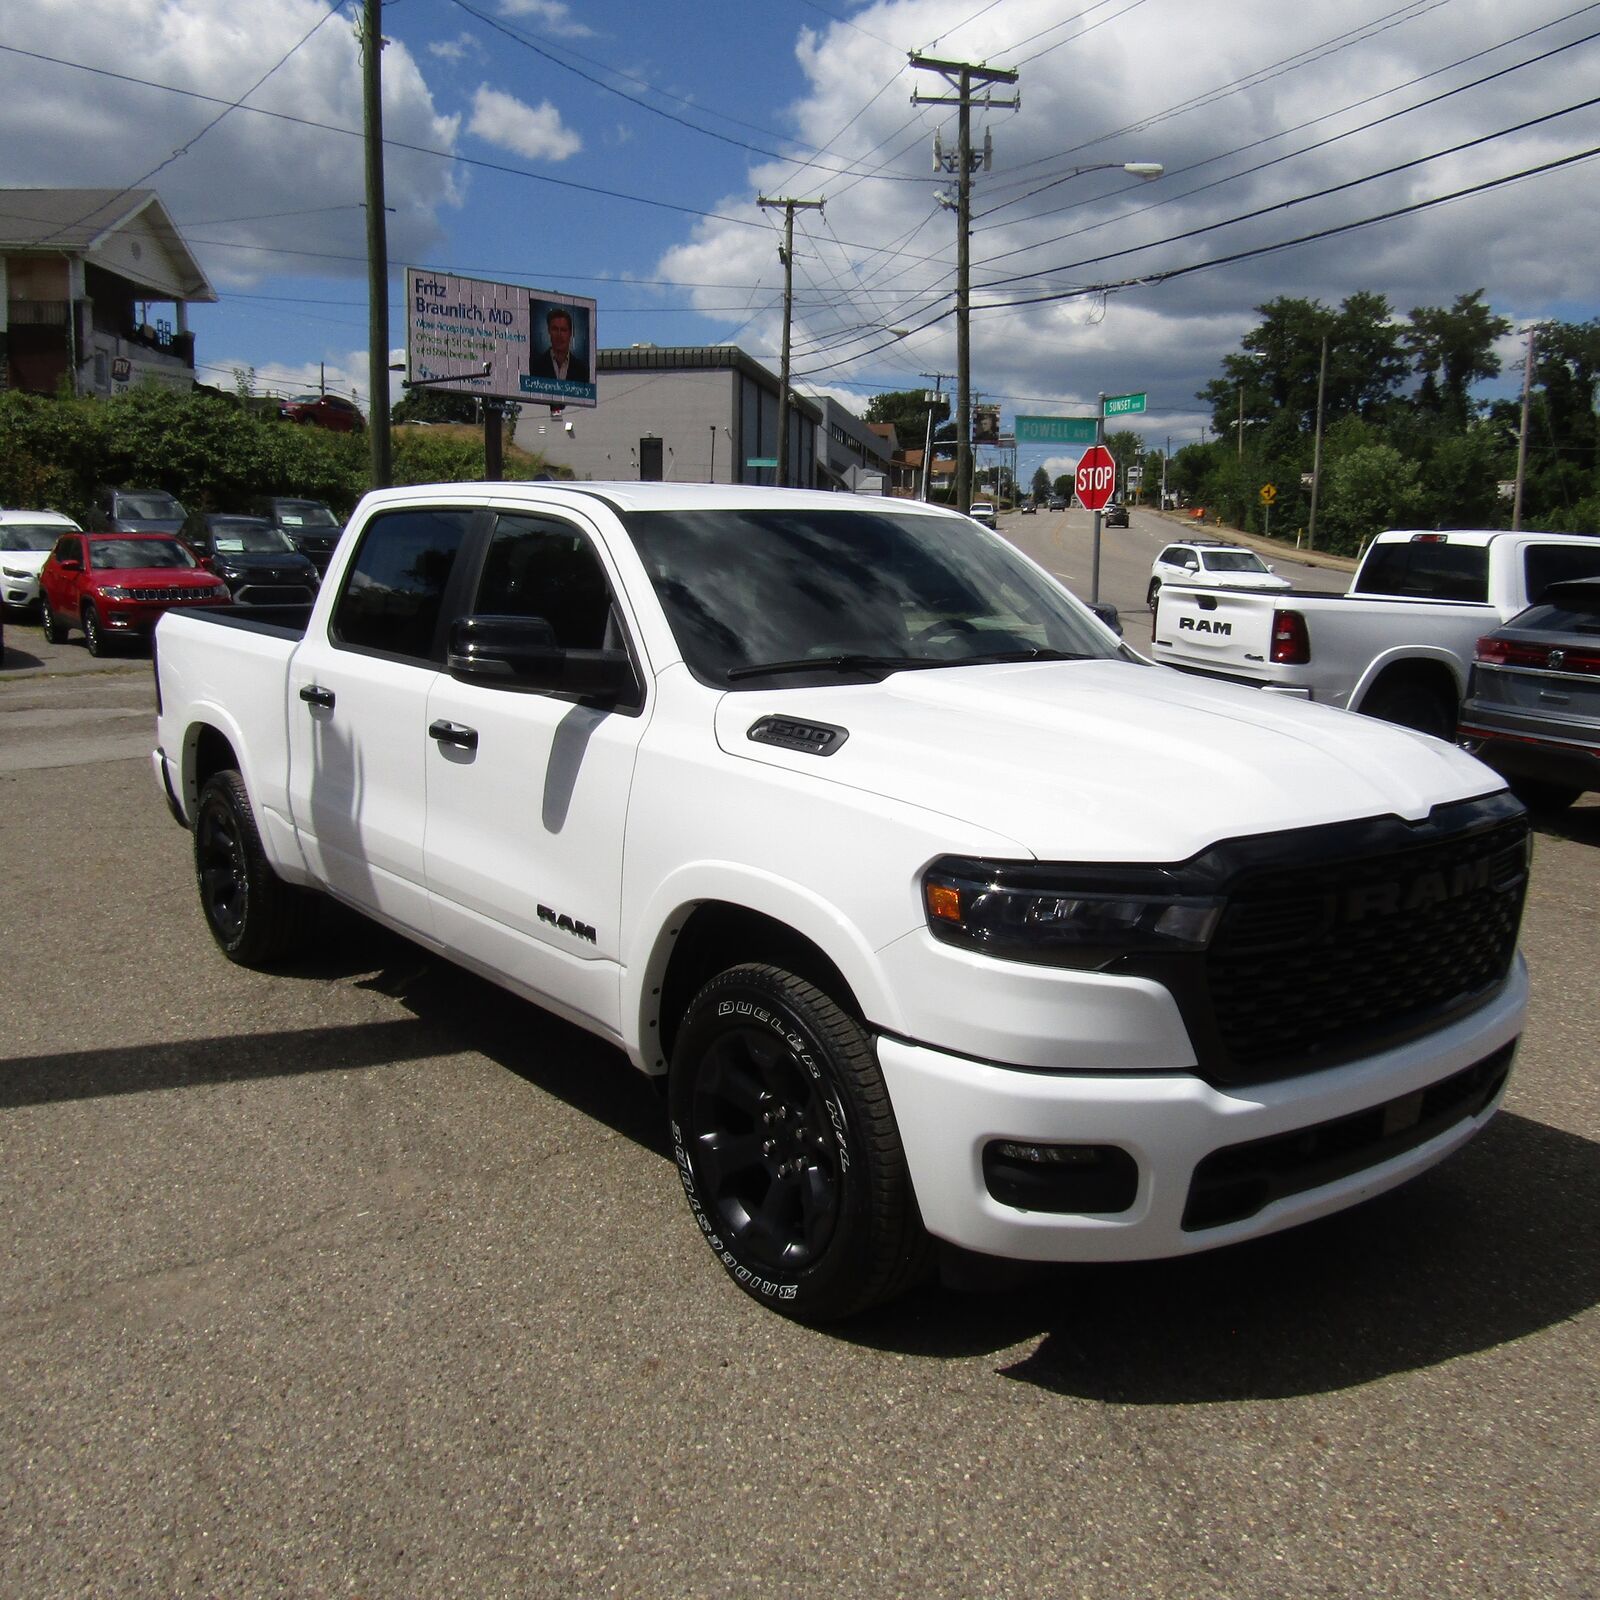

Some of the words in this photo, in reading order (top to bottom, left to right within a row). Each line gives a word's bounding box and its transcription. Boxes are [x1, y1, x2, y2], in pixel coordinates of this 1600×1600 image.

[415, 278, 447, 298] Fritz
[415, 297, 486, 324] Braunlich,
[489, 307, 513, 326] MD
[1109, 399, 1131, 413] SUNSET
[1023, 422, 1069, 438] POWELL
[1078, 466, 1113, 492] STOP
[1179, 617, 1232, 635] RAM
[1346, 857, 1490, 920] RAM
[536, 903, 597, 945] RAM
[718, 1000, 821, 1079] DUELER
[671, 1119, 799, 1299] BRIDGESTONE
